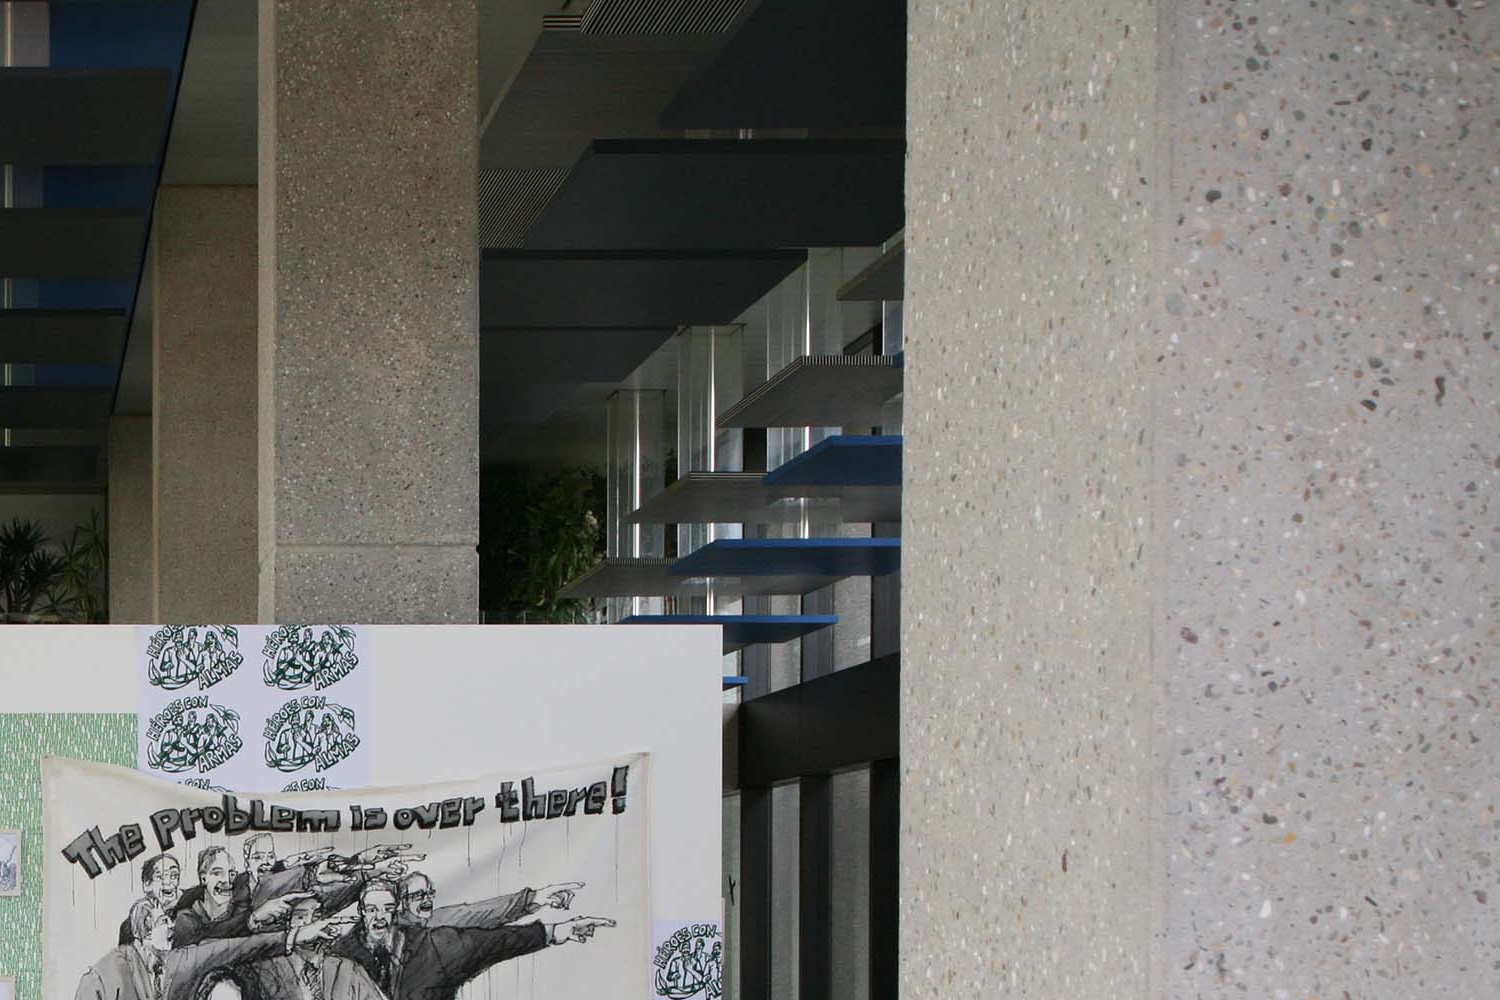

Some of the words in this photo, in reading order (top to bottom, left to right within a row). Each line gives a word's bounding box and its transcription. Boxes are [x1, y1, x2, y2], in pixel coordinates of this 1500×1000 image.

[198, 650, 244, 690] ALMAS
[313, 650, 359, 691] ARMAS
[183, 696, 209, 712] CON
[300, 696, 326, 711] CON
[198, 733, 244, 773] ARMAS
[314, 732, 360, 773] ALMAS
[61, 823, 147, 880] The
[150, 794, 341, 851] Problem
[350, 804, 388, 831] is
[393, 796, 485, 831] over
[495, 765, 630, 823] there!
[691, 924, 717, 938] CON
